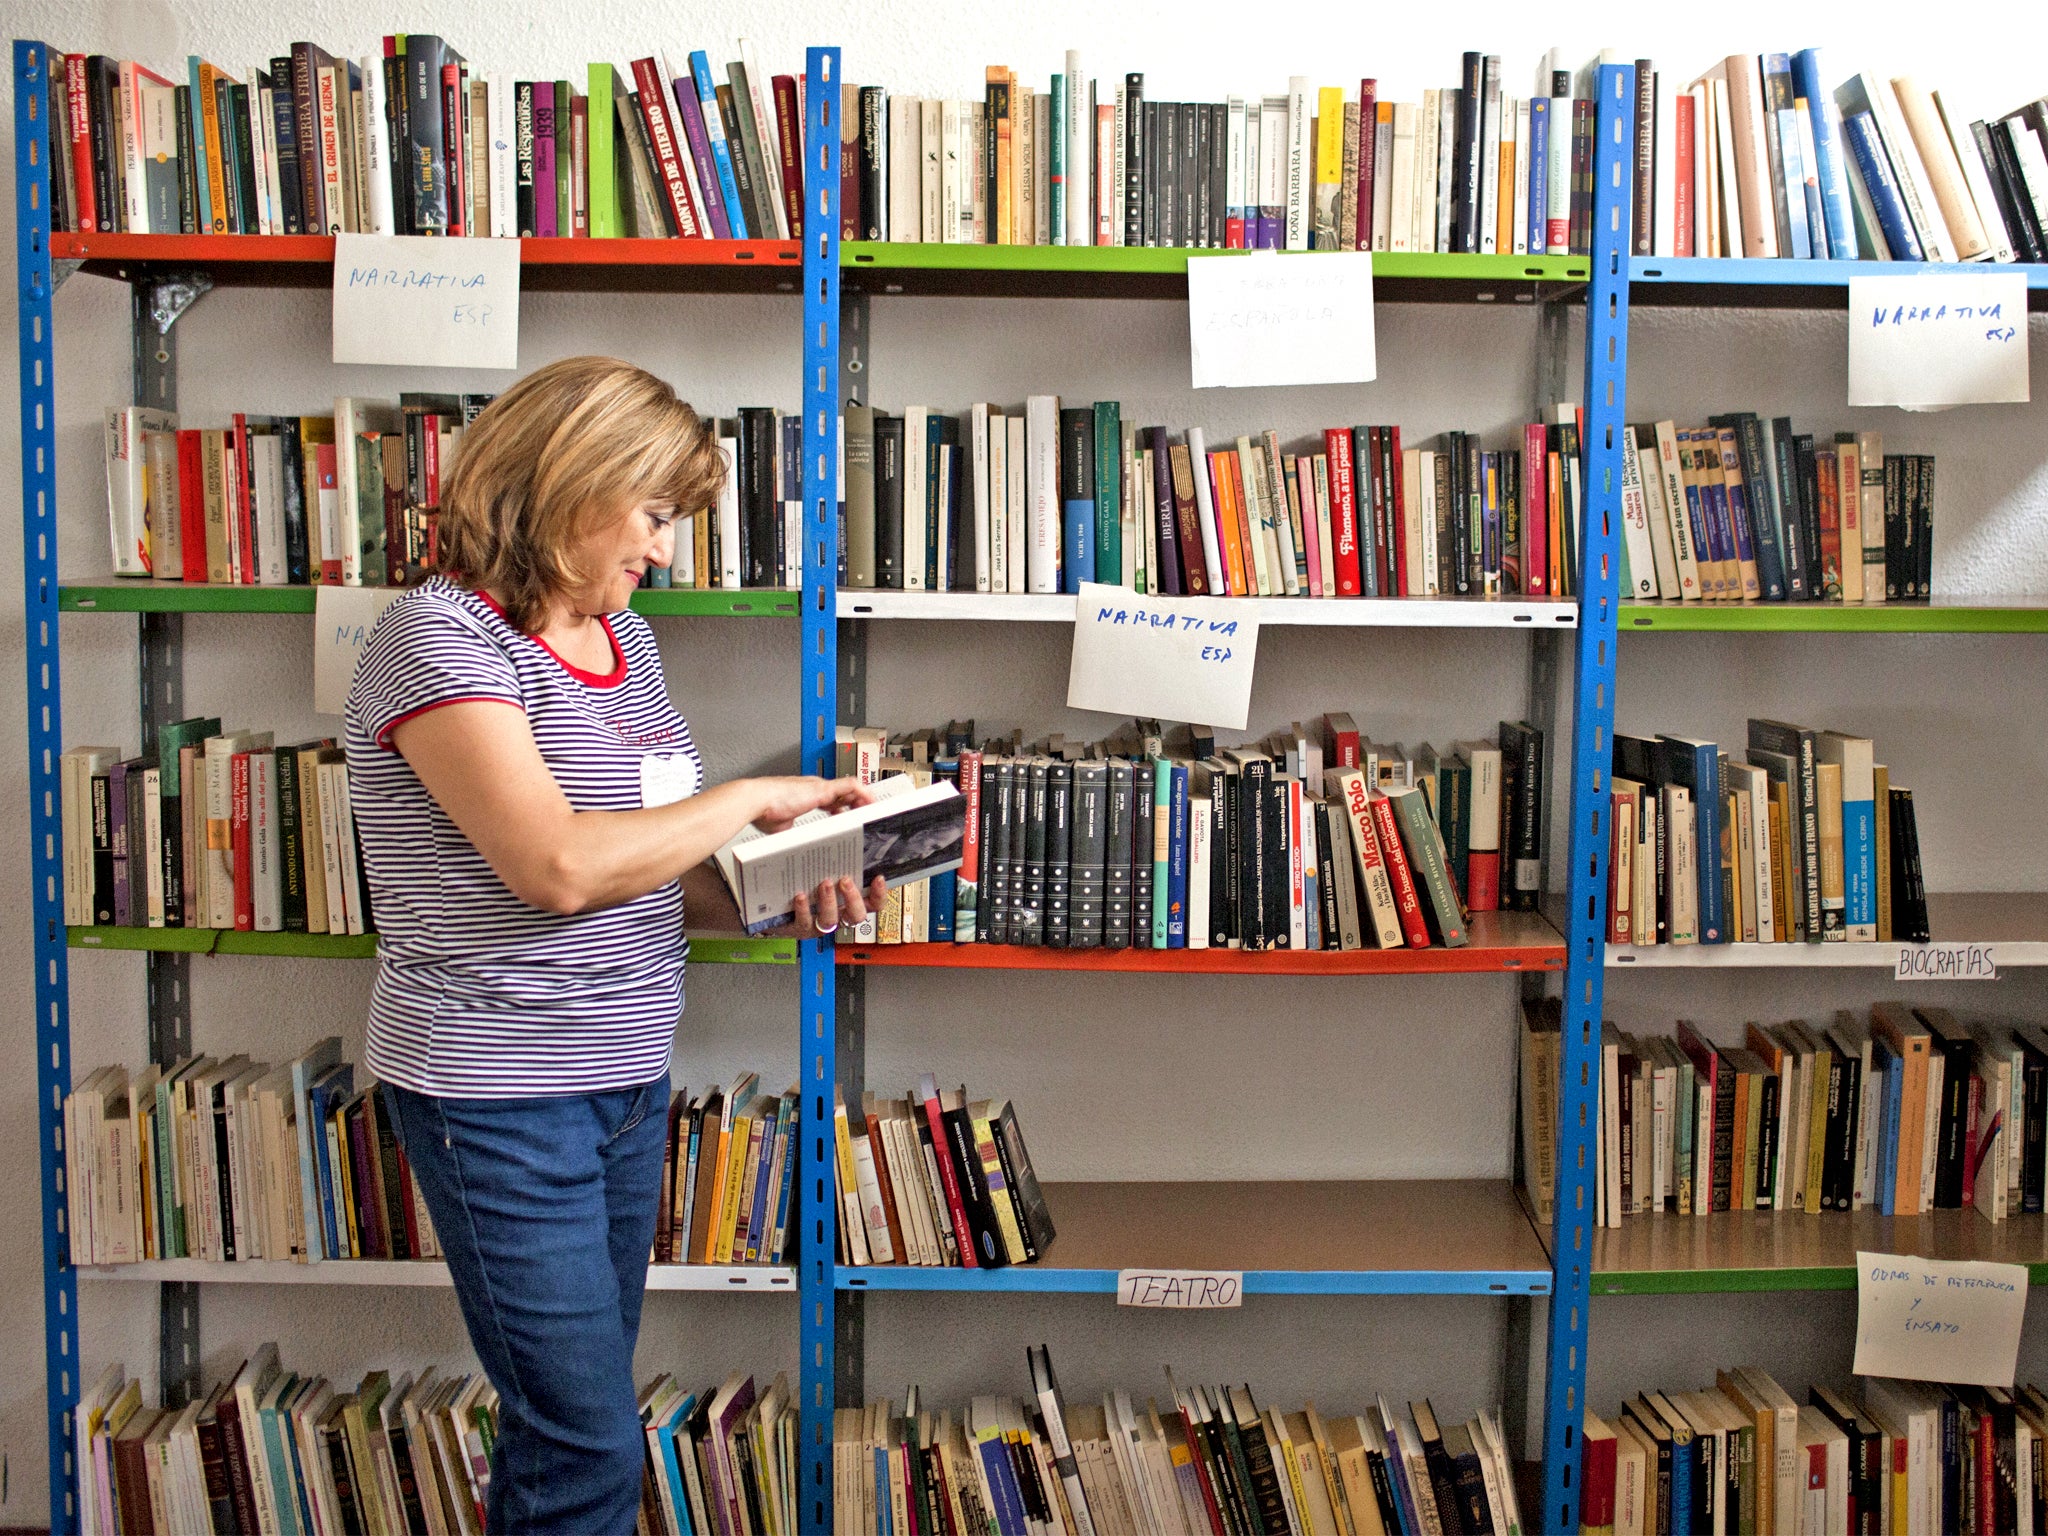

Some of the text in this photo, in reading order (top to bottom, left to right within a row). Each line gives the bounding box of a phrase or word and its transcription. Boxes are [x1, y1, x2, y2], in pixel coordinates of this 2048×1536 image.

[67, 60, 78, 92] Delgado
[70, 94, 78, 103] G.
[76, 60, 88, 134] La mirada del otro
[295, 51, 314, 154] TIERRA FIRME
[71, 105, 80, 143] Fernando
[322, 76, 337, 183] EL CRIMEN DE CUENCA
[535, 107, 553, 140] 1939
[1639, 68, 1652, 170] TIERRA FIRME
[516, 85, 534, 187] Las Respetuosas
[648, 105, 697, 237] MONTES DE HIERRO
[1291, 149, 1301, 206] BARBARA
[1289, 209, 1300, 241] DOÑA
[348, 268, 487, 289] NARRATIVA
[453, 303, 494, 328] ESP
[1872, 303, 2002, 328] NARRATIVA
[1338, 434, 1350, 467] pesar
[1626, 432, 1639, 485] privilegiada
[1264, 434, 1282, 527] Gonzalo Torrente Ballester
[1339, 468, 1348, 483] mi
[1669, 474, 1681, 505] escritor
[1625, 493, 1635, 520] María
[1633, 492, 1644, 529] Casares
[1676, 507, 1683, 519] un
[1339, 493, 1353, 555] Filomeno,
[1679, 530, 1689, 561] Retrato
[1097, 607, 1239, 637] NARRATIVA
[1200, 645, 1233, 663] ESP
[1526, 742, 1535, 762] DIGO
[211, 758, 221, 815] JUAN MARSÉ
[258, 762, 266, 783] jardín
[961, 759, 969, 790] Marías
[970, 760, 978, 790] blanco
[1526, 764, 1535, 790] AHORA
[241, 785, 248, 793] la
[280, 757, 298, 896] ANTONIO GALA El águila bicéfala
[969, 809, 977, 844] Corazón
[1346, 780, 1382, 869] Marco Polo
[1525, 808, 1534, 838] NOMBRE
[1802, 740, 1819, 933] LAS CARTAS DE AMOR DE FRANCO V.Gracia/E.Salgado
[1380, 803, 1416, 913] En busca del unicornio
[1525, 840, 1532, 850] EL
[1899, 945, 1995, 977] BIOGRAFÍAS
[1622, 1155, 1630, 1169] AÑOS
[1126, 1275, 1238, 1306] TEATRO
[1922, 1274, 1937, 1286] DE
[1905, 1318, 1960, 1335] ENSAYO
